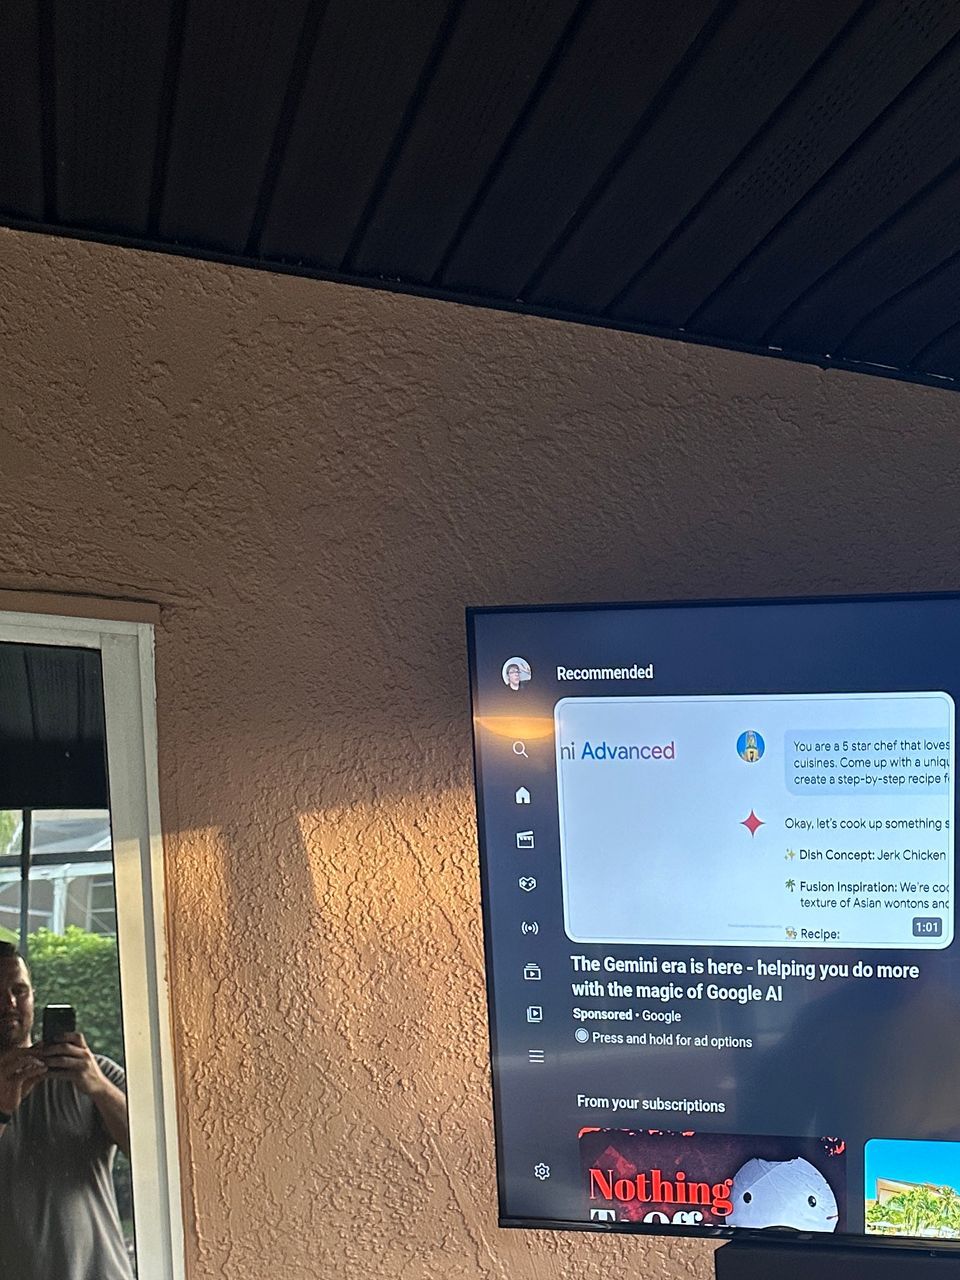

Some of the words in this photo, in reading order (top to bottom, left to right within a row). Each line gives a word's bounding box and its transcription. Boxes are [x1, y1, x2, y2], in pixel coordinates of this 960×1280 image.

[556, 664, 654, 681] Recommended
[581, 741, 675, 760] Advanced
[794, 741, 812, 751] You
[815, 742, 831, 751] are
[834, 743, 840, 751] a
[842, 741, 848, 751] 5
[852, 742, 871, 751] star
[874, 740, 898, 751] chef
[900, 740, 921, 750] that
[924, 739, 950, 750] loves
[794, 757, 838, 768] cuisines.
[840, 757, 871, 768] Come
[874, 759, 887, 770] up
[890, 757, 912, 767] with
[914, 759, 921, 767] a
[794, 774, 826, 784] create
[829, 776, 835, 784] a
[838, 773, 906, 786] step-by-step
[908, 773, 941, 786] recipe
[785, 818, 814, 830] Okay,
[817, 818, 837, 829] let's
[840, 818, 866, 829] cook
[869, 820, 882, 831] up
[885, 817, 942, 831] something
[800, 850, 822, 860] Dish
[826, 849, 875, 862] Concept:
[877, 850, 900, 860] Jerk
[902, 849, 946, 860] Chicken
[800, 881, 834, 892] Fusion
[837, 881, 897, 894] Inspiration:
[900, 882, 930, 893] We're
[800, 898, 836, 908] texture
[840, 898, 851, 908] of
[853, 898, 881, 908] Asian
[884, 899, 930, 909] wontons
[801, 928, 840, 941] Recipe:
[916, 922, 938, 933] 1:01
[570, 956, 600, 972] The
[604, 956, 658, 973] Gemini
[662, 960, 686, 974] era
[690, 958, 704, 974] is
[708, 958, 743, 975] here
[757, 959, 815, 980] helping
[819, 964, 848, 980] you
[852, 961, 873, 978] do
[877, 965, 919, 978] more
[572, 980, 604, 997] with
[608, 981, 633, 997] the
[636, 982, 683, 1002] magic
[687, 983, 703, 999] of
[706, 984, 762, 1004] Google
[765, 986, 783, 1001] AI
[573, 1007, 633, 1022] Sponsored
[642, 1009, 682, 1024] Google
[592, 1031, 623, 1044] Press
[626, 1033, 646, 1045] and
[649, 1033, 673, 1045] hold
[676, 1034, 691, 1046] for
[694, 1035, 708, 1047] ad
[710, 1036, 752, 1049] options
[577, 1094, 609, 1108] From
[612, 1099, 639, 1112] your
[642, 1098, 726, 1114] subscriptions
[588, 1168, 734, 1216] Nothing
